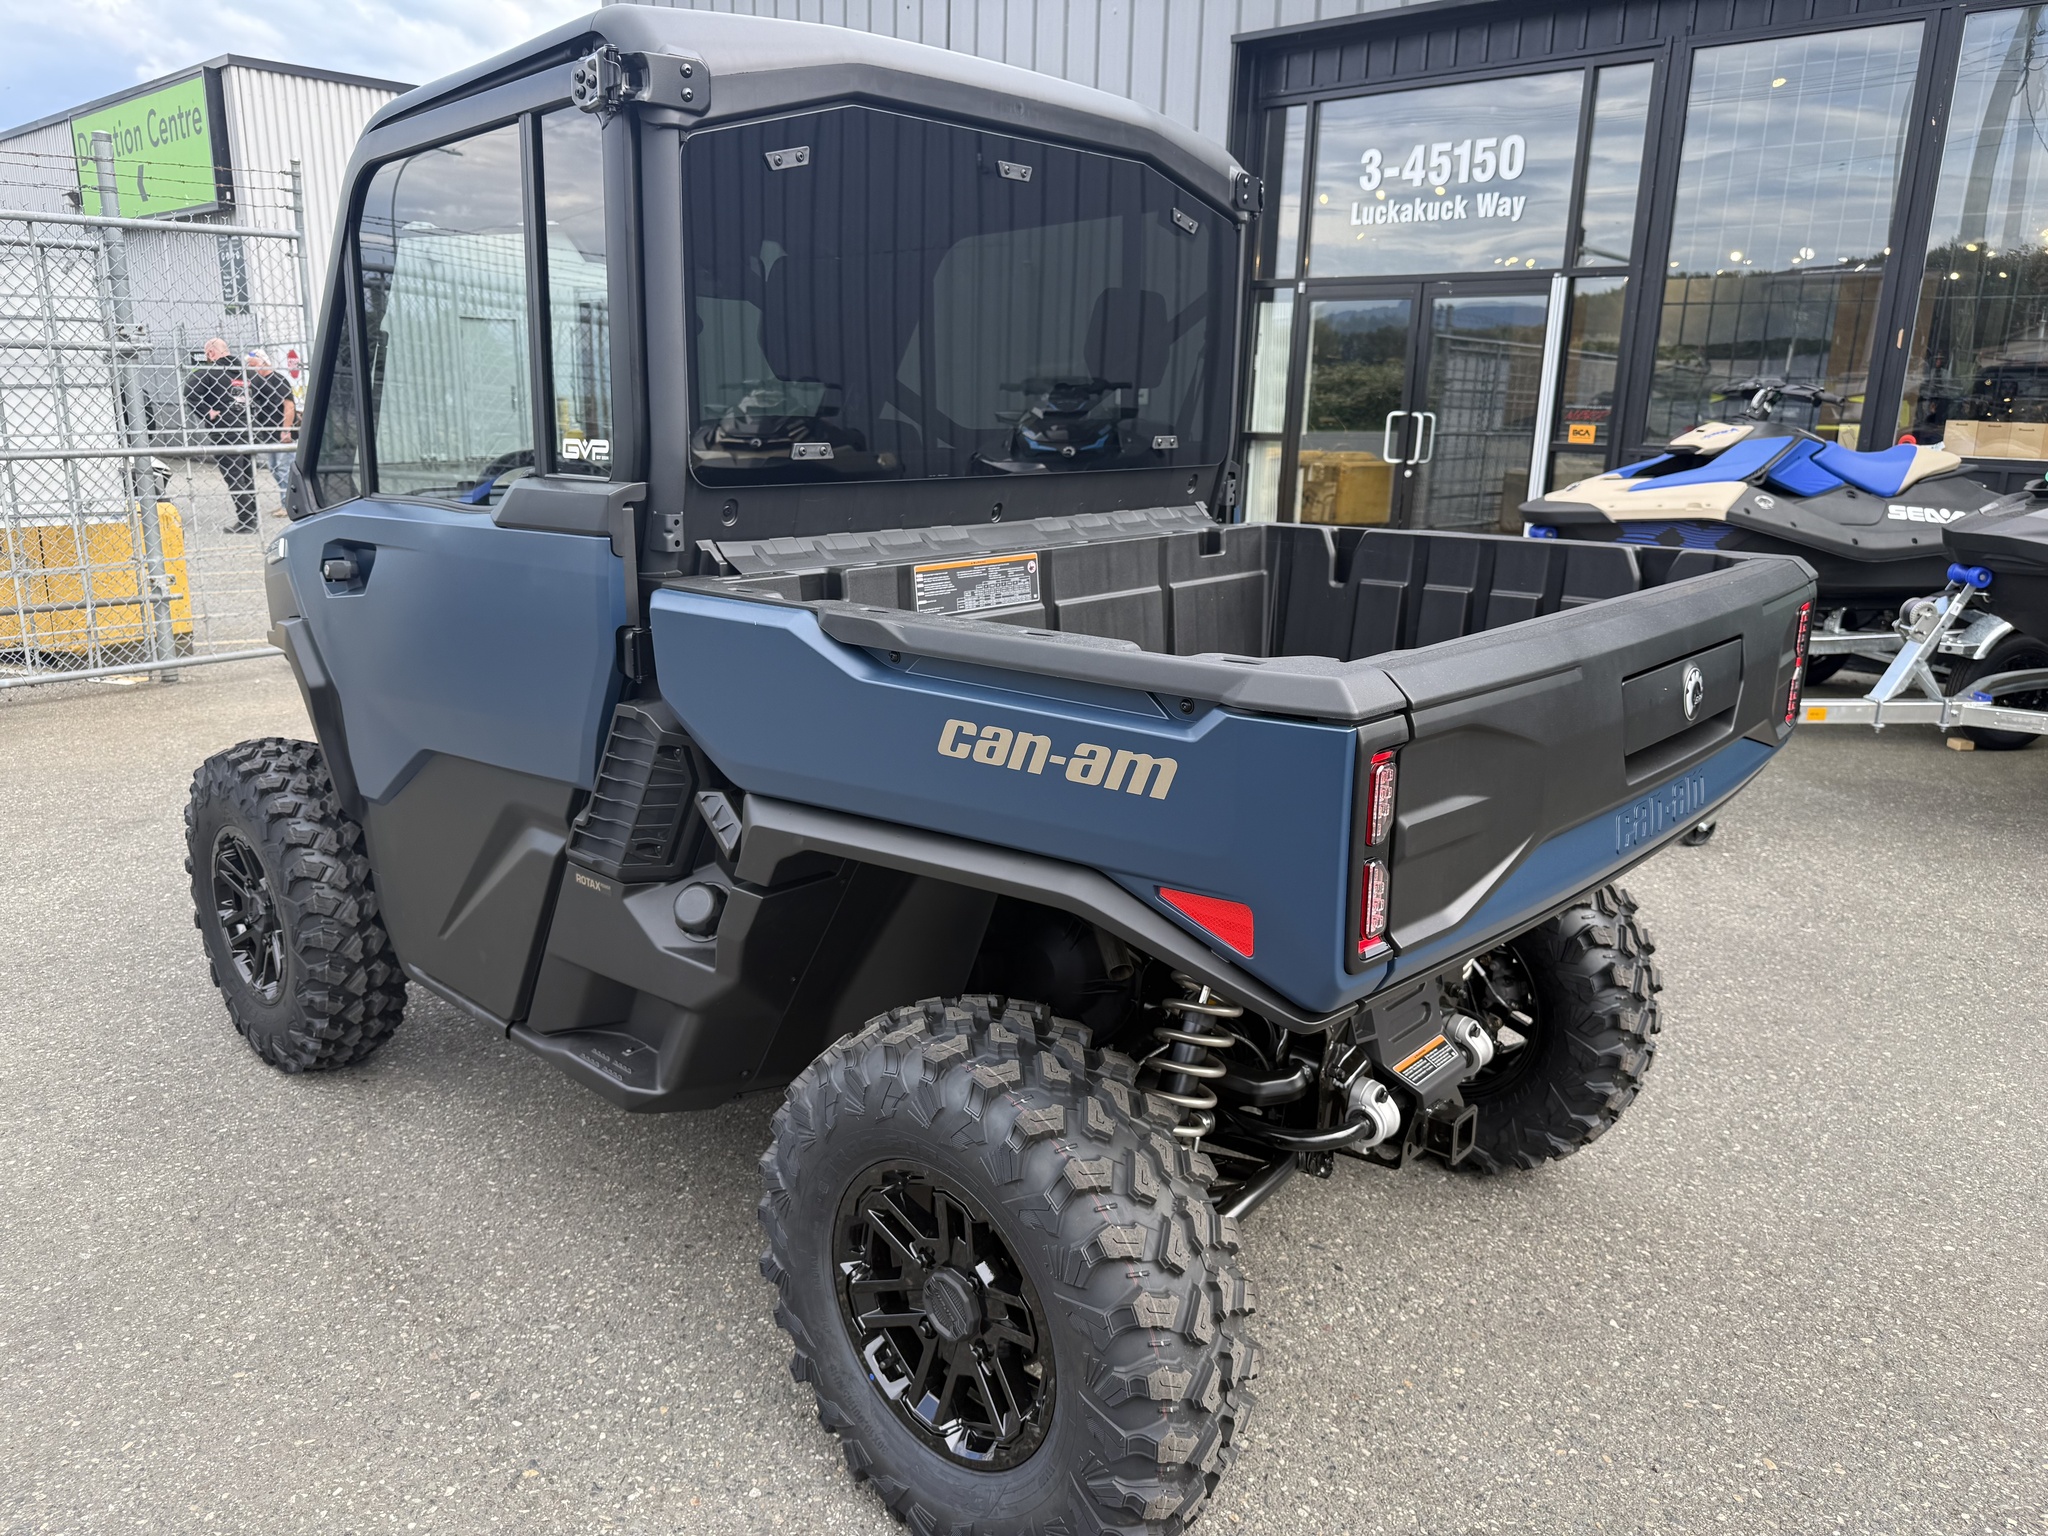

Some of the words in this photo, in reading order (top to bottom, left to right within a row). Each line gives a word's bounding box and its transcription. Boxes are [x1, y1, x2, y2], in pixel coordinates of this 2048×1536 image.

[77, 120, 144, 167] Dtion
[147, 105, 203, 148] Centre
[1359, 134, 1526, 191] 3-45150
[1350, 194, 1469, 226] Luckakuck
[1476, 192, 1527, 222] Way
[562, 438, 610, 461] GVP
[937, 718, 1179, 801] can-am
[1615, 768, 1705, 856] can-am
[575, 872, 601, 892] ROTAX
